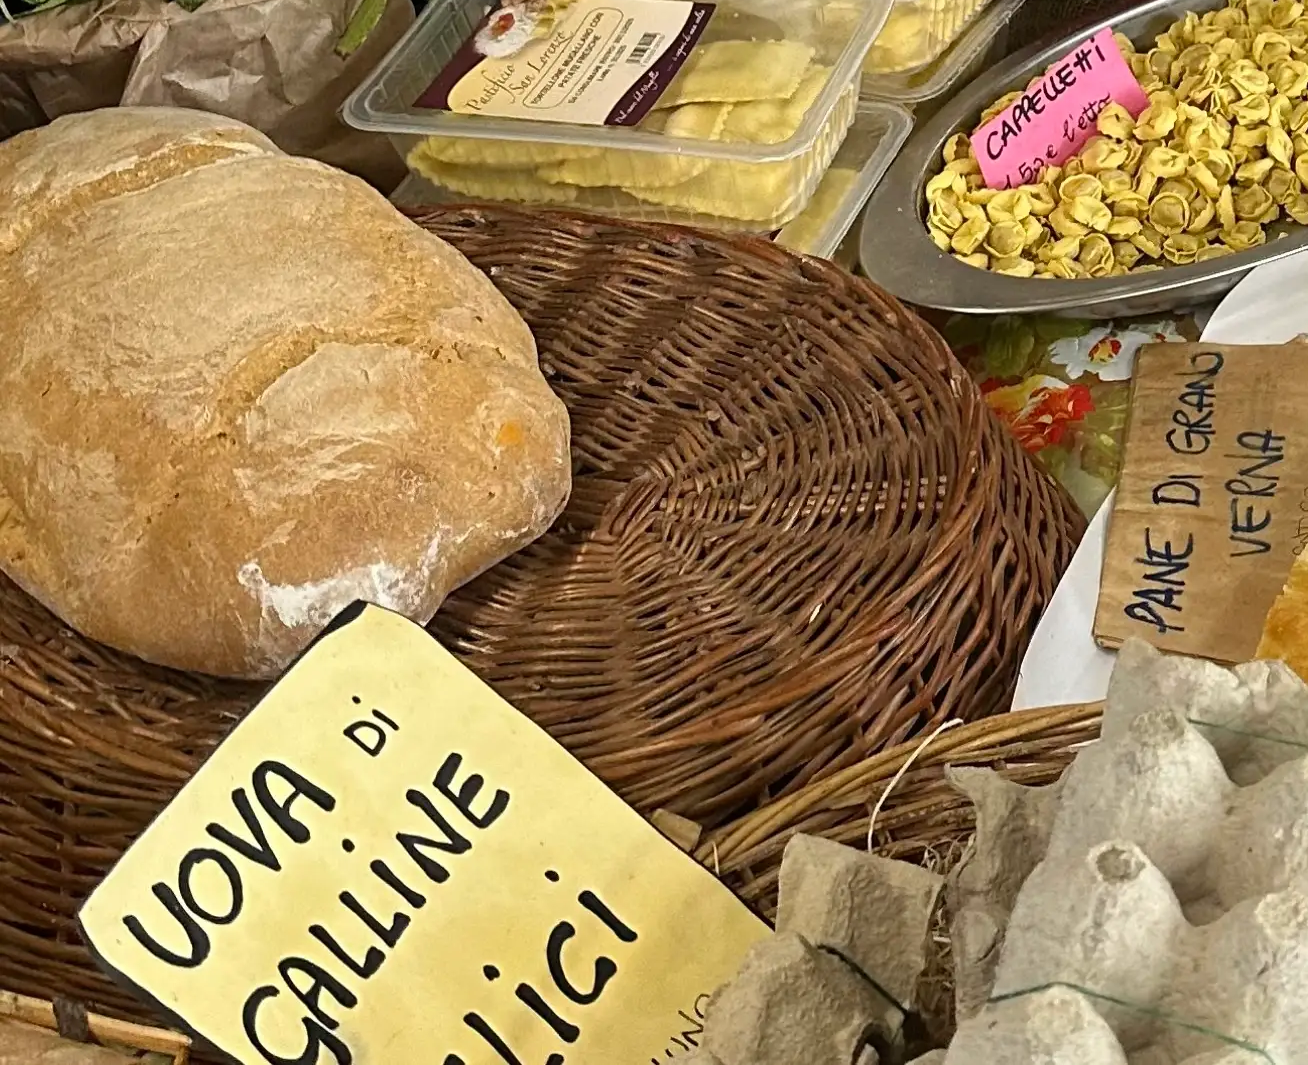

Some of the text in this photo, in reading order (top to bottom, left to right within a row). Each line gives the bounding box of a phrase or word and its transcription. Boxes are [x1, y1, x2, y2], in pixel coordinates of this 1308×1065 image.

[986, 36, 1106, 160] CAPPELLETTI
[1152, 475, 1204, 508] DI
[1224, 430, 1286, 558] VERNA
[1123, 526, 1194, 633] PANE
[122, 760, 336, 969] UOVA
[242, 751, 511, 1065] GALLINE
[440, 871, 638, 1065] LICI
